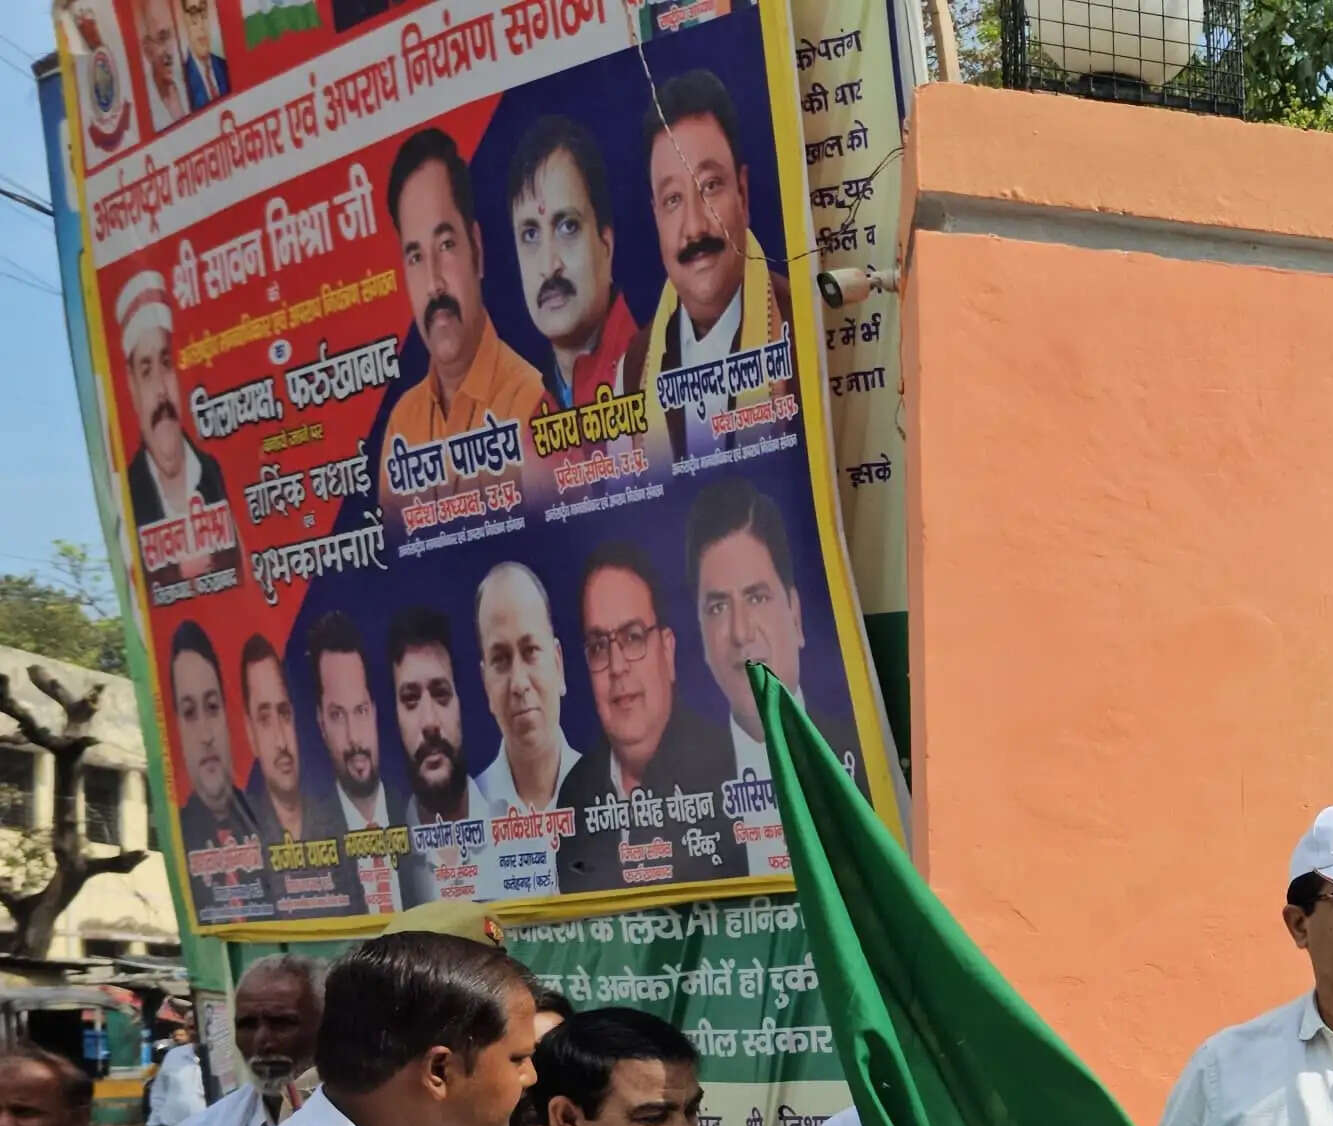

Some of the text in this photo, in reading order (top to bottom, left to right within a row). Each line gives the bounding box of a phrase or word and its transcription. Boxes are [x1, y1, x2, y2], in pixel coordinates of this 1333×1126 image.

[818, 29, 862, 61] पतंग
[174, 109, 286, 199] मानवाधिकार
[285, 71, 319, 150] एवं
[323, 54, 399, 132] अपराध
[402, 9, 497, 96] नियंत्रण
[802, 82, 829, 115] की
[846, 120, 869, 151] को
[172, 162, 378, 310] श्री सावन मिश्रा जी
[656, 359, 726, 422] श्यामसुन्दर
[725, 348, 763, 393] लल्ला
[763, 321, 794, 382] वर्मा
[529, 383, 649, 458] संजय कटियार
[711, 410, 736, 440] प्रदेश
[387, 434, 447, 496] धीरज
[448, 409, 524, 477] पाण्डेय
[244, 463, 305, 524] हार्दिक
[554, 458, 585, 495] प्रदेश
[139, 490, 237, 573] सावन मिश्रा
[401, 494, 437, 536] प्रदेश
[544, 806, 577, 850] गुप्ता
[584, 791, 630, 834] संजीव
[630, 785, 665, 828] सिंह
[305, 839, 340, 867] यादव
[733, 822, 761, 844] जिला
[618, 907, 684, 945] लिये
[566, 964, 592, 1000] से
[596, 963, 683, 1002] अनेकों
[737, 957, 764, 999] हो
[741, 1016, 833, 1057] स्वीकार
